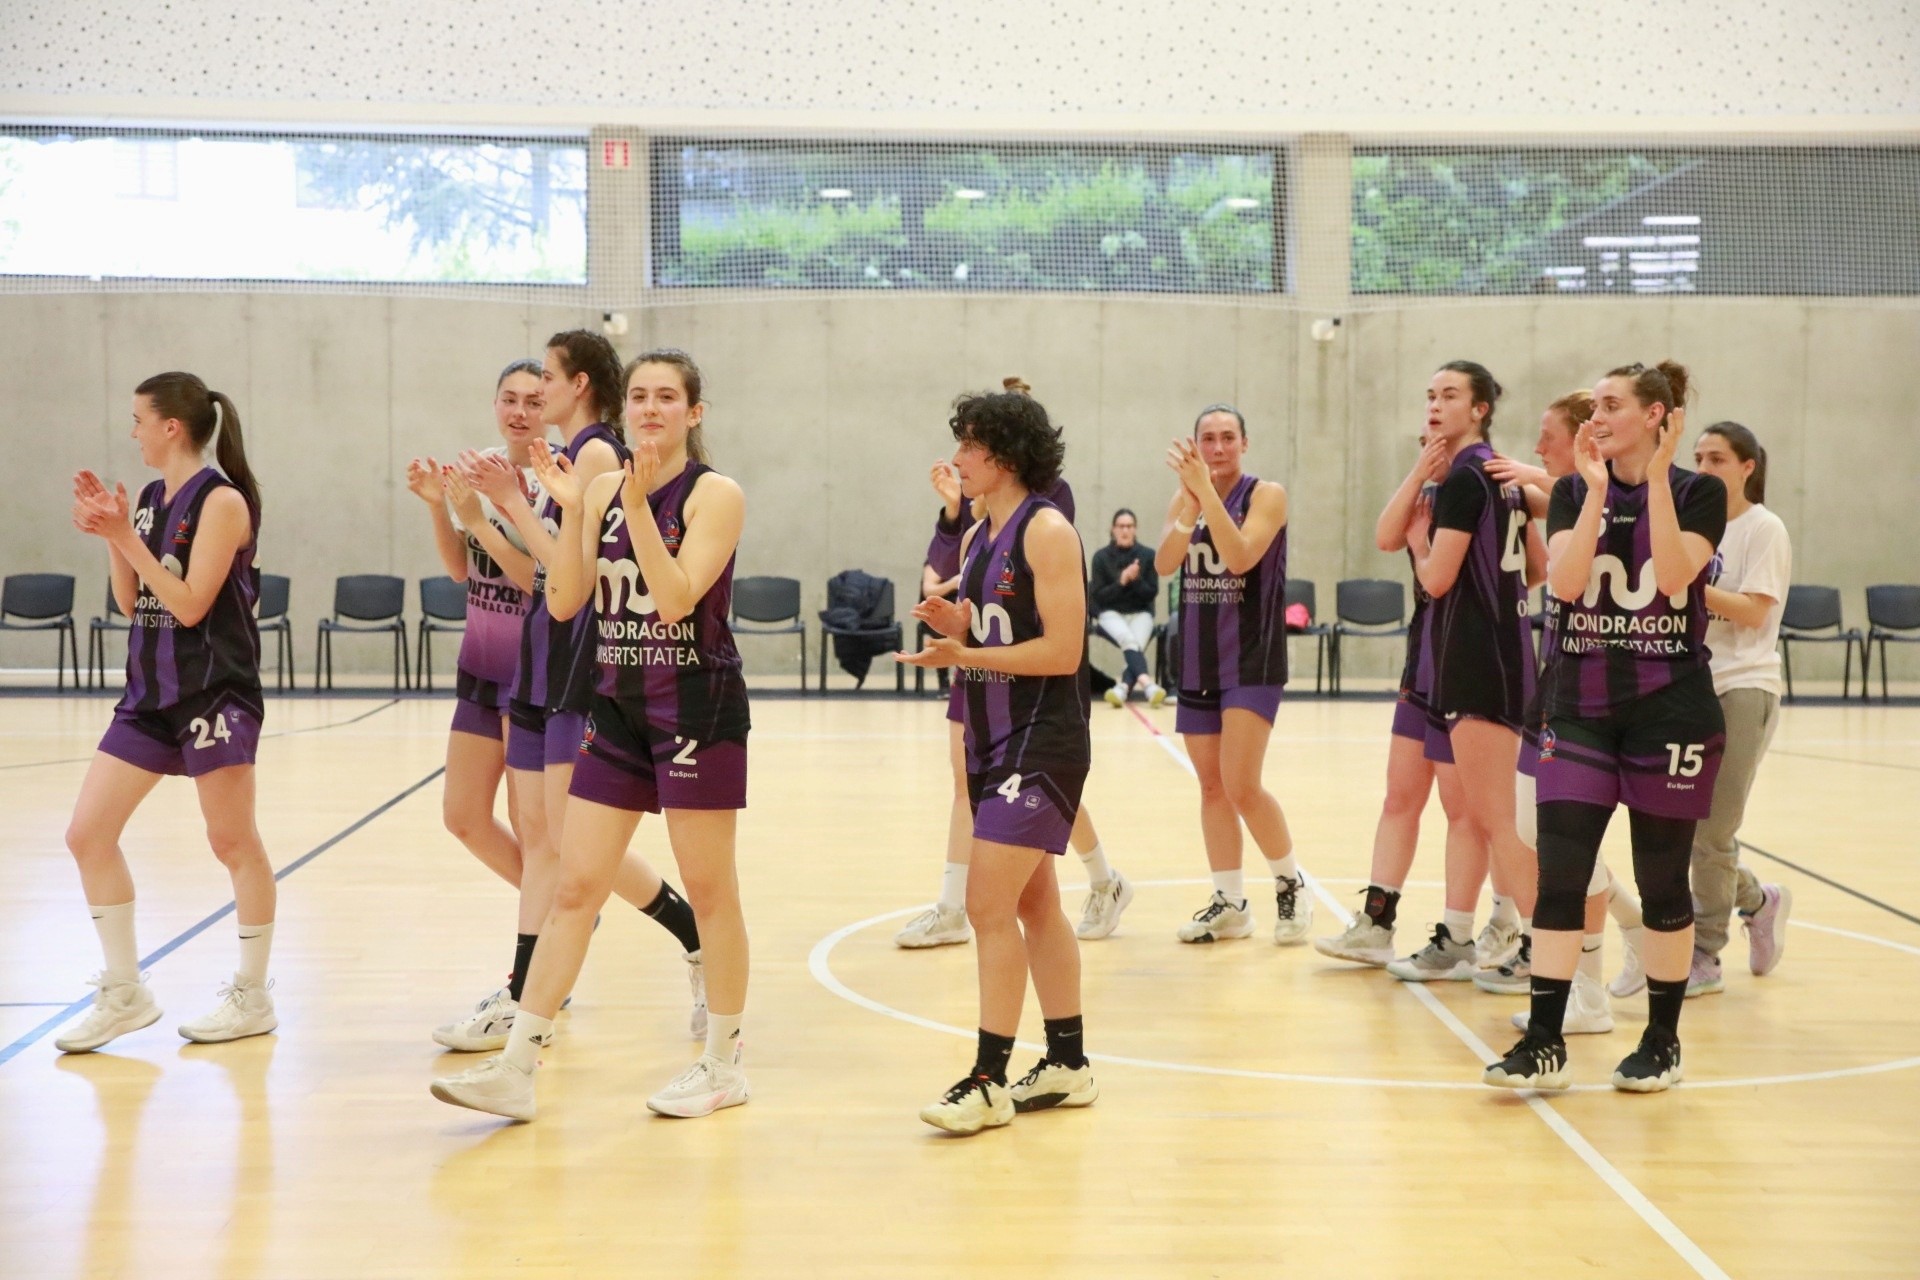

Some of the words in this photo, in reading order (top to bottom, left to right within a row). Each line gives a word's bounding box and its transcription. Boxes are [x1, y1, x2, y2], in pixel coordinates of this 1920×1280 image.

[601, 506, 625, 543] 2
[190, 713, 232, 750] 24
[672, 735, 698, 765] 2
[1665, 743, 1705, 777] 15
[669, 770, 698, 779] EuSport
[997, 773, 1022, 804] 4
